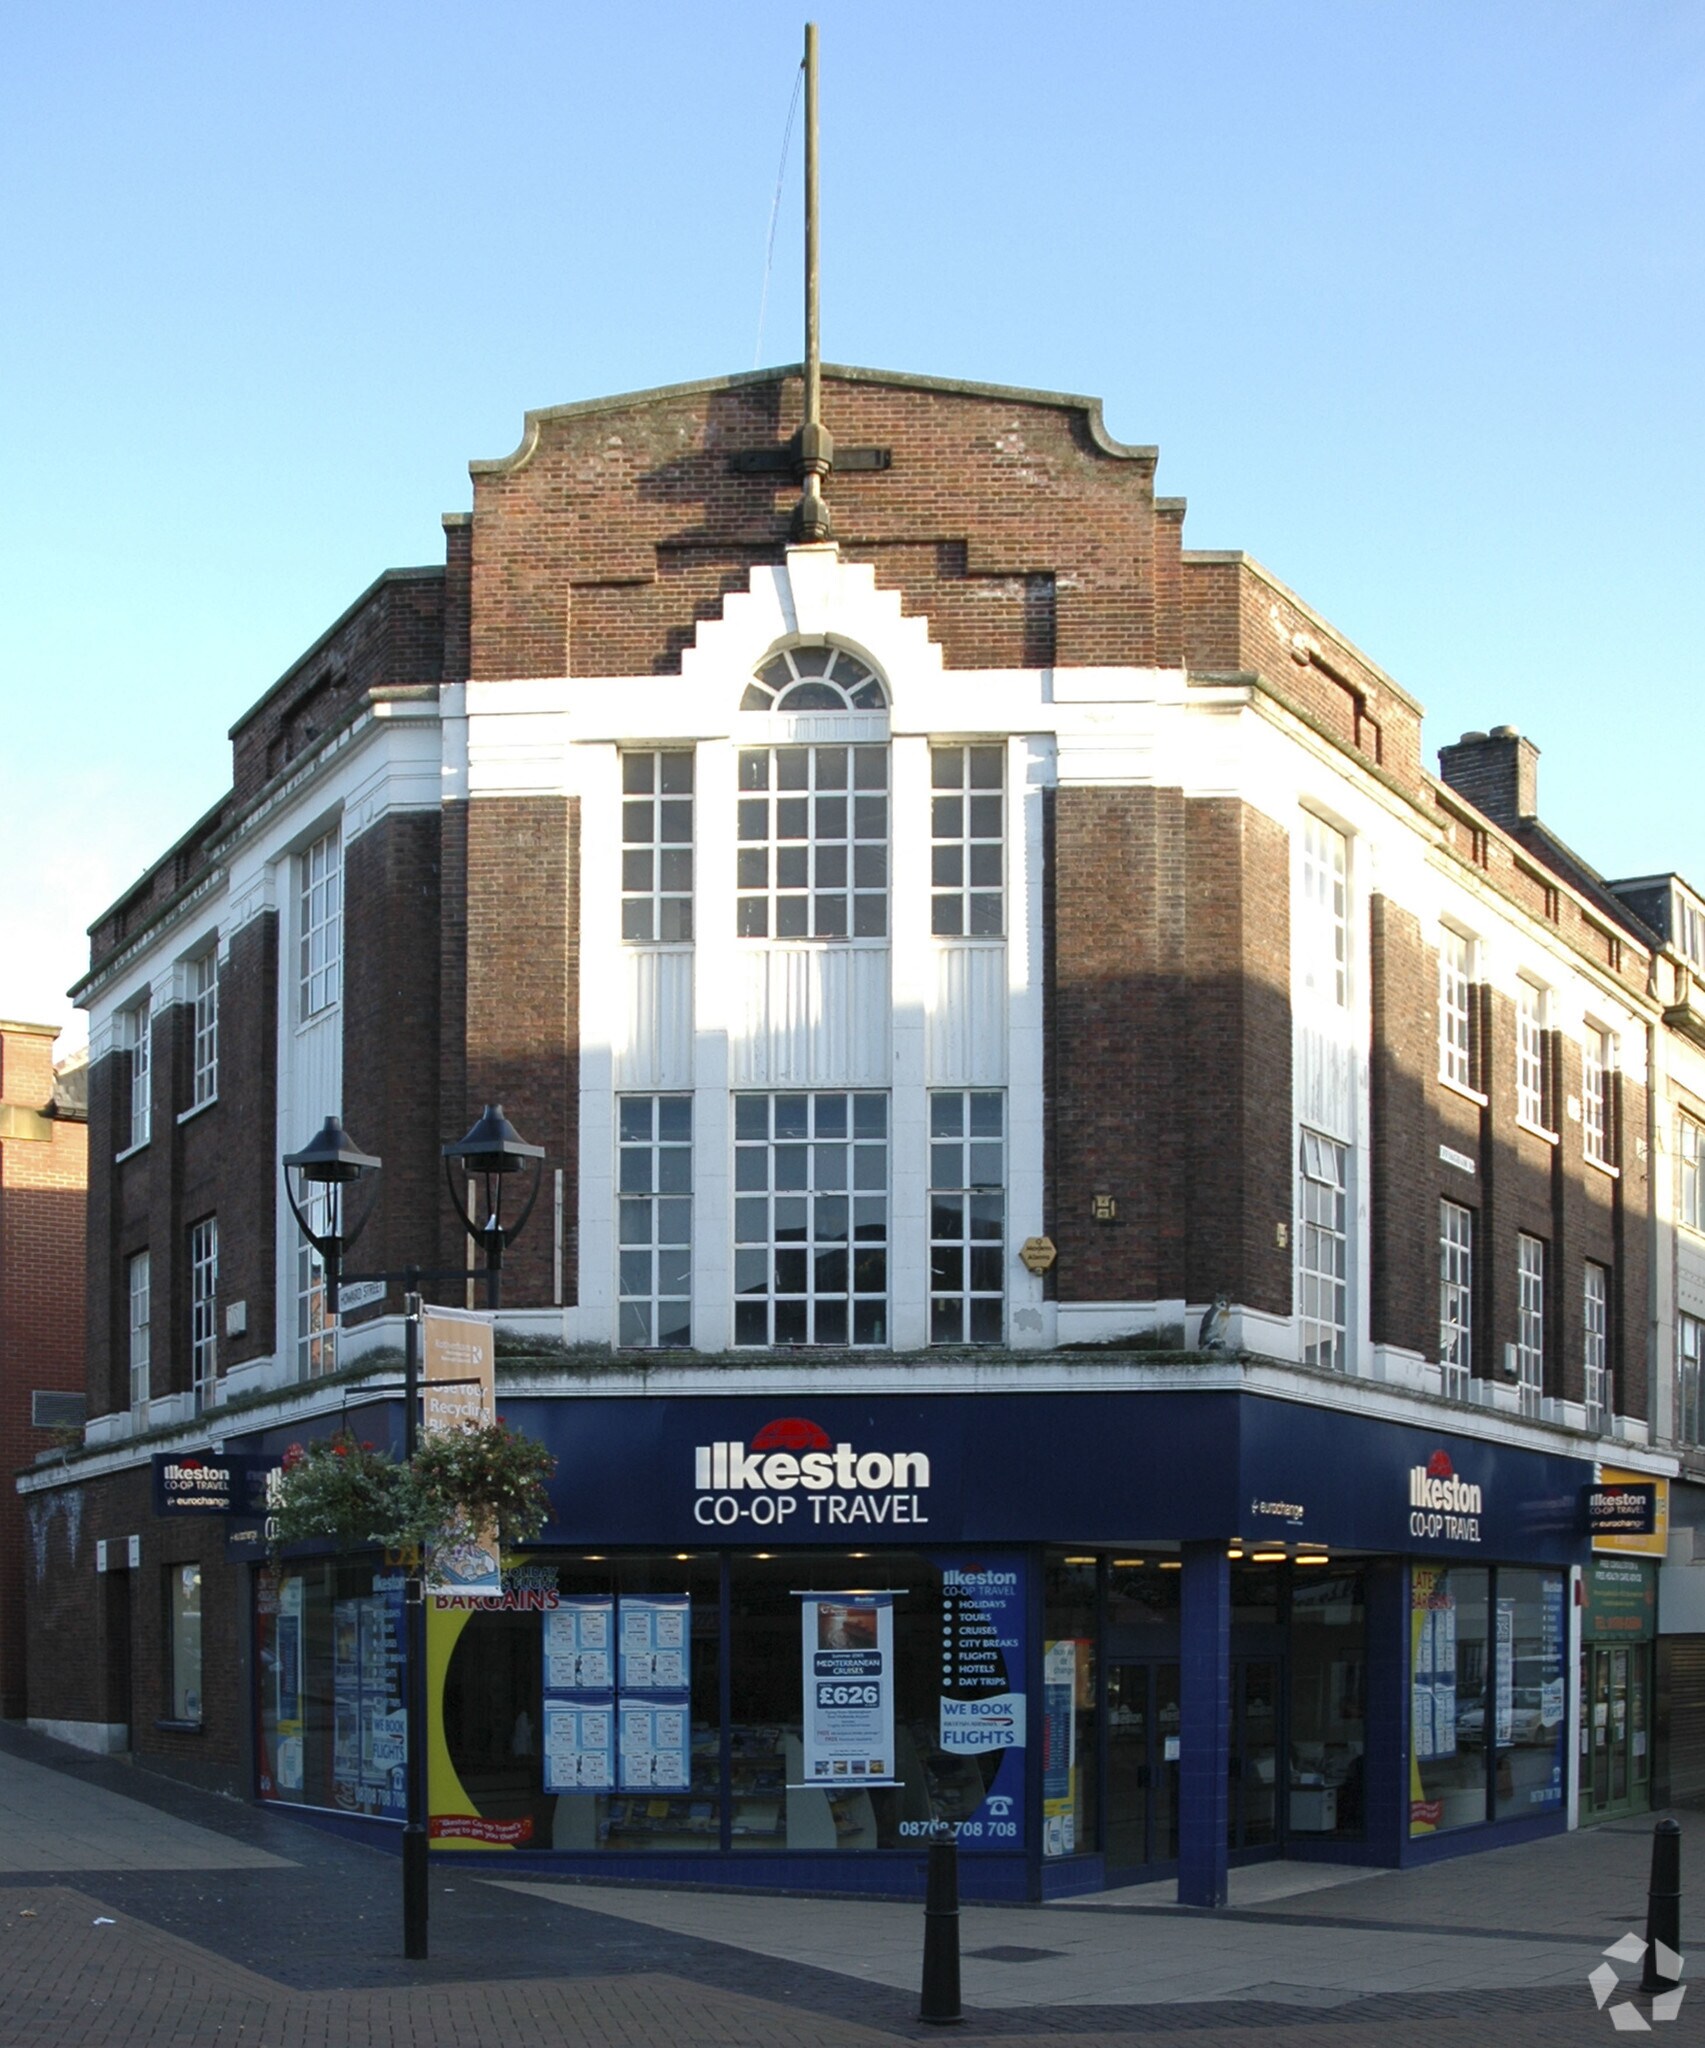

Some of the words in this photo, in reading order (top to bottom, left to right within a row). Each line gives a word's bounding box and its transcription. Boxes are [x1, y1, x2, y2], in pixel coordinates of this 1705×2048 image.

[430, 1397, 491, 1422] Recycling
[696, 1441, 930, 1490] Ilkeston
[163, 1464, 230, 1481] Ilkeston
[163, 1480, 195, 1491] CO-OP
[196, 1480, 230, 1492] TRAVEL
[1410, 1465, 1482, 1515] Ilkeston
[176, 1496, 230, 1508] eurochange
[1590, 1493, 1647, 1507] Ilkeston
[694, 1495, 797, 1525] CO-OP
[807, 1495, 929, 1524] TRAVEL
[1260, 1501, 1304, 1520] eurochange
[1590, 1505, 1615, 1515] CO-OP
[1616, 1505, 1646, 1515] TRAVEL
[1410, 1511, 1443, 1538] CO-OP
[1444, 1515, 1482, 1543] TRAVEL
[943, 1570, 1017, 1585] Ilkeston
[943, 1586, 975, 1596] CO-OP
[980, 1586, 1016, 1596] TRAVEL
[435, 1588, 560, 1611] BARGAINS
[959, 1600, 1006, 1608] HOLIDAYS
[959, 1613, 992, 1621] TOURS
[959, 1626, 997, 1634] CRUISES
[959, 1639, 981, 1648] CITY
[983, 1639, 1018, 1647] BREAKS
[959, 1652, 997, 1660] FLIGHTS
[817, 1660, 880, 1668] MEDITERRANEAN
[959, 1665, 995, 1673] HOTELS
[833, 1667, 864, 1675] CRUISES
[959, 1677, 978, 1685] DAY
[980, 1677, 1006, 1686] TRIPS
[819, 1686, 878, 1705] £626
[944, 1704, 966, 1714] WE
[971, 1703, 1013, 1715] BOOK
[374, 1718, 385, 1731] WE
[386, 1718, 405, 1733] BOOK
[943, 1731, 1014, 1744] FLIGHTS
[373, 1743, 405, 1760] FLIGHTS
[954, 1821, 983, 1836] 708
[988, 1821, 1017, 1836] 708
